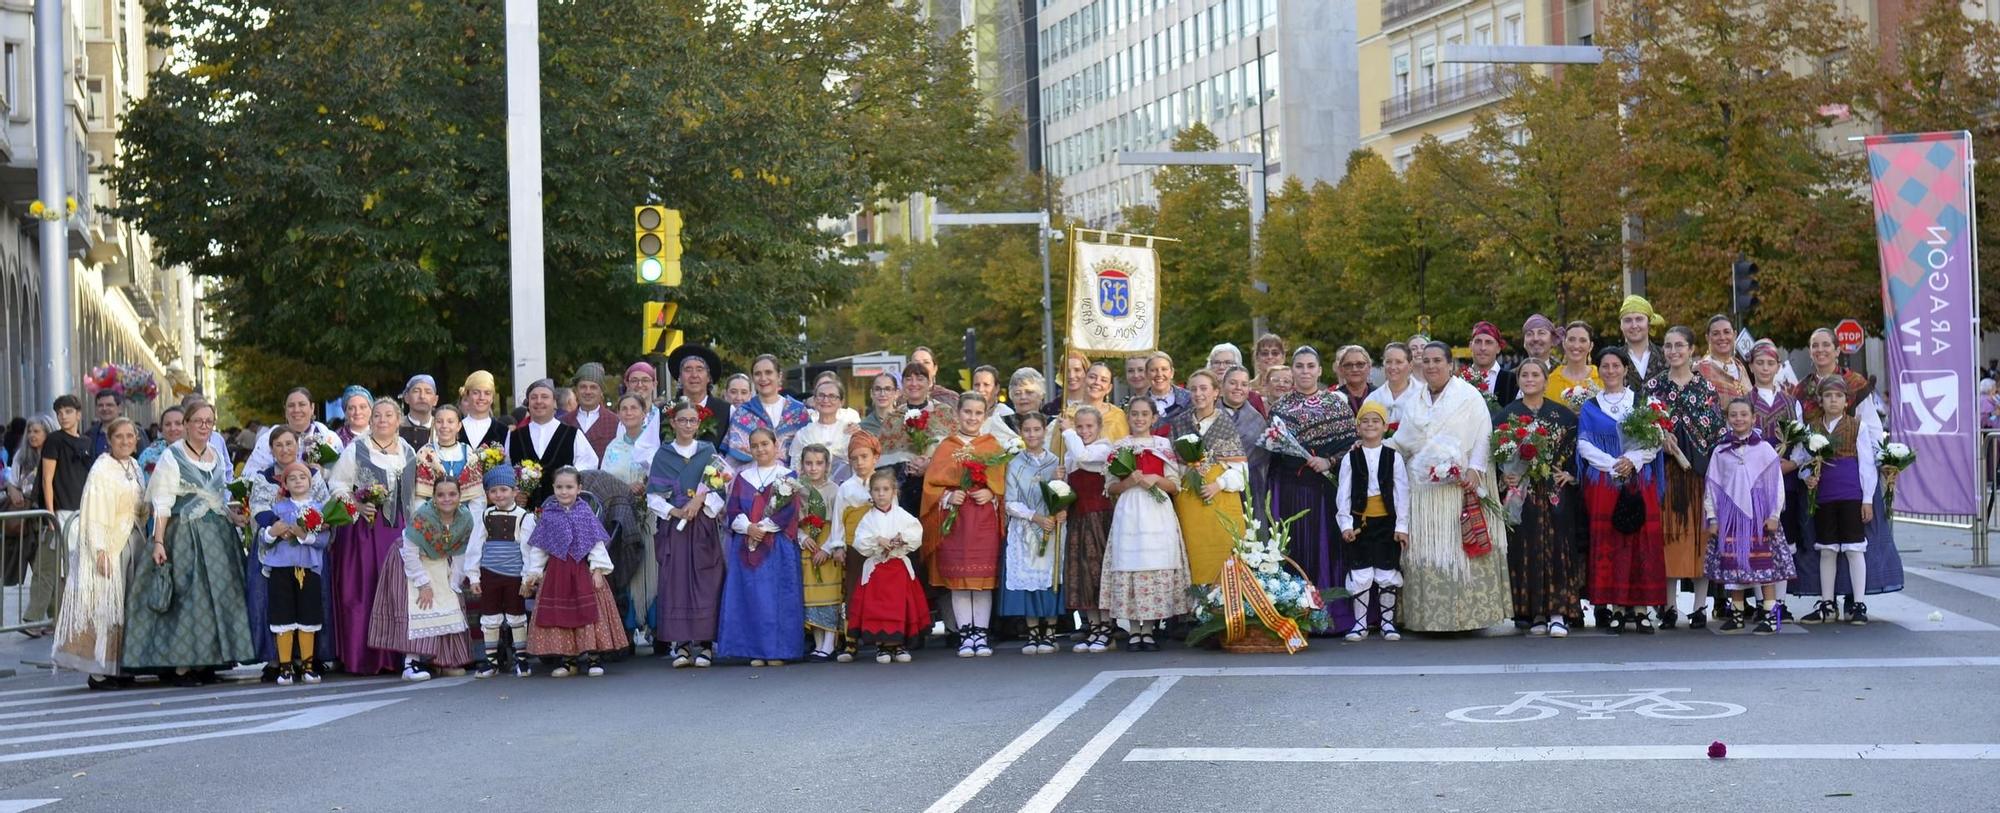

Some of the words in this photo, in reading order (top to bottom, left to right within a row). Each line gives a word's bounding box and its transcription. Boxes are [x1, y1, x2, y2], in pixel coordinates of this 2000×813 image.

[1081, 297, 1094, 325] VERA
[1095, 325, 1109, 337] DE
[1114, 301, 1145, 339] MONCAYO
[1838, 332, 1860, 341] STOP
